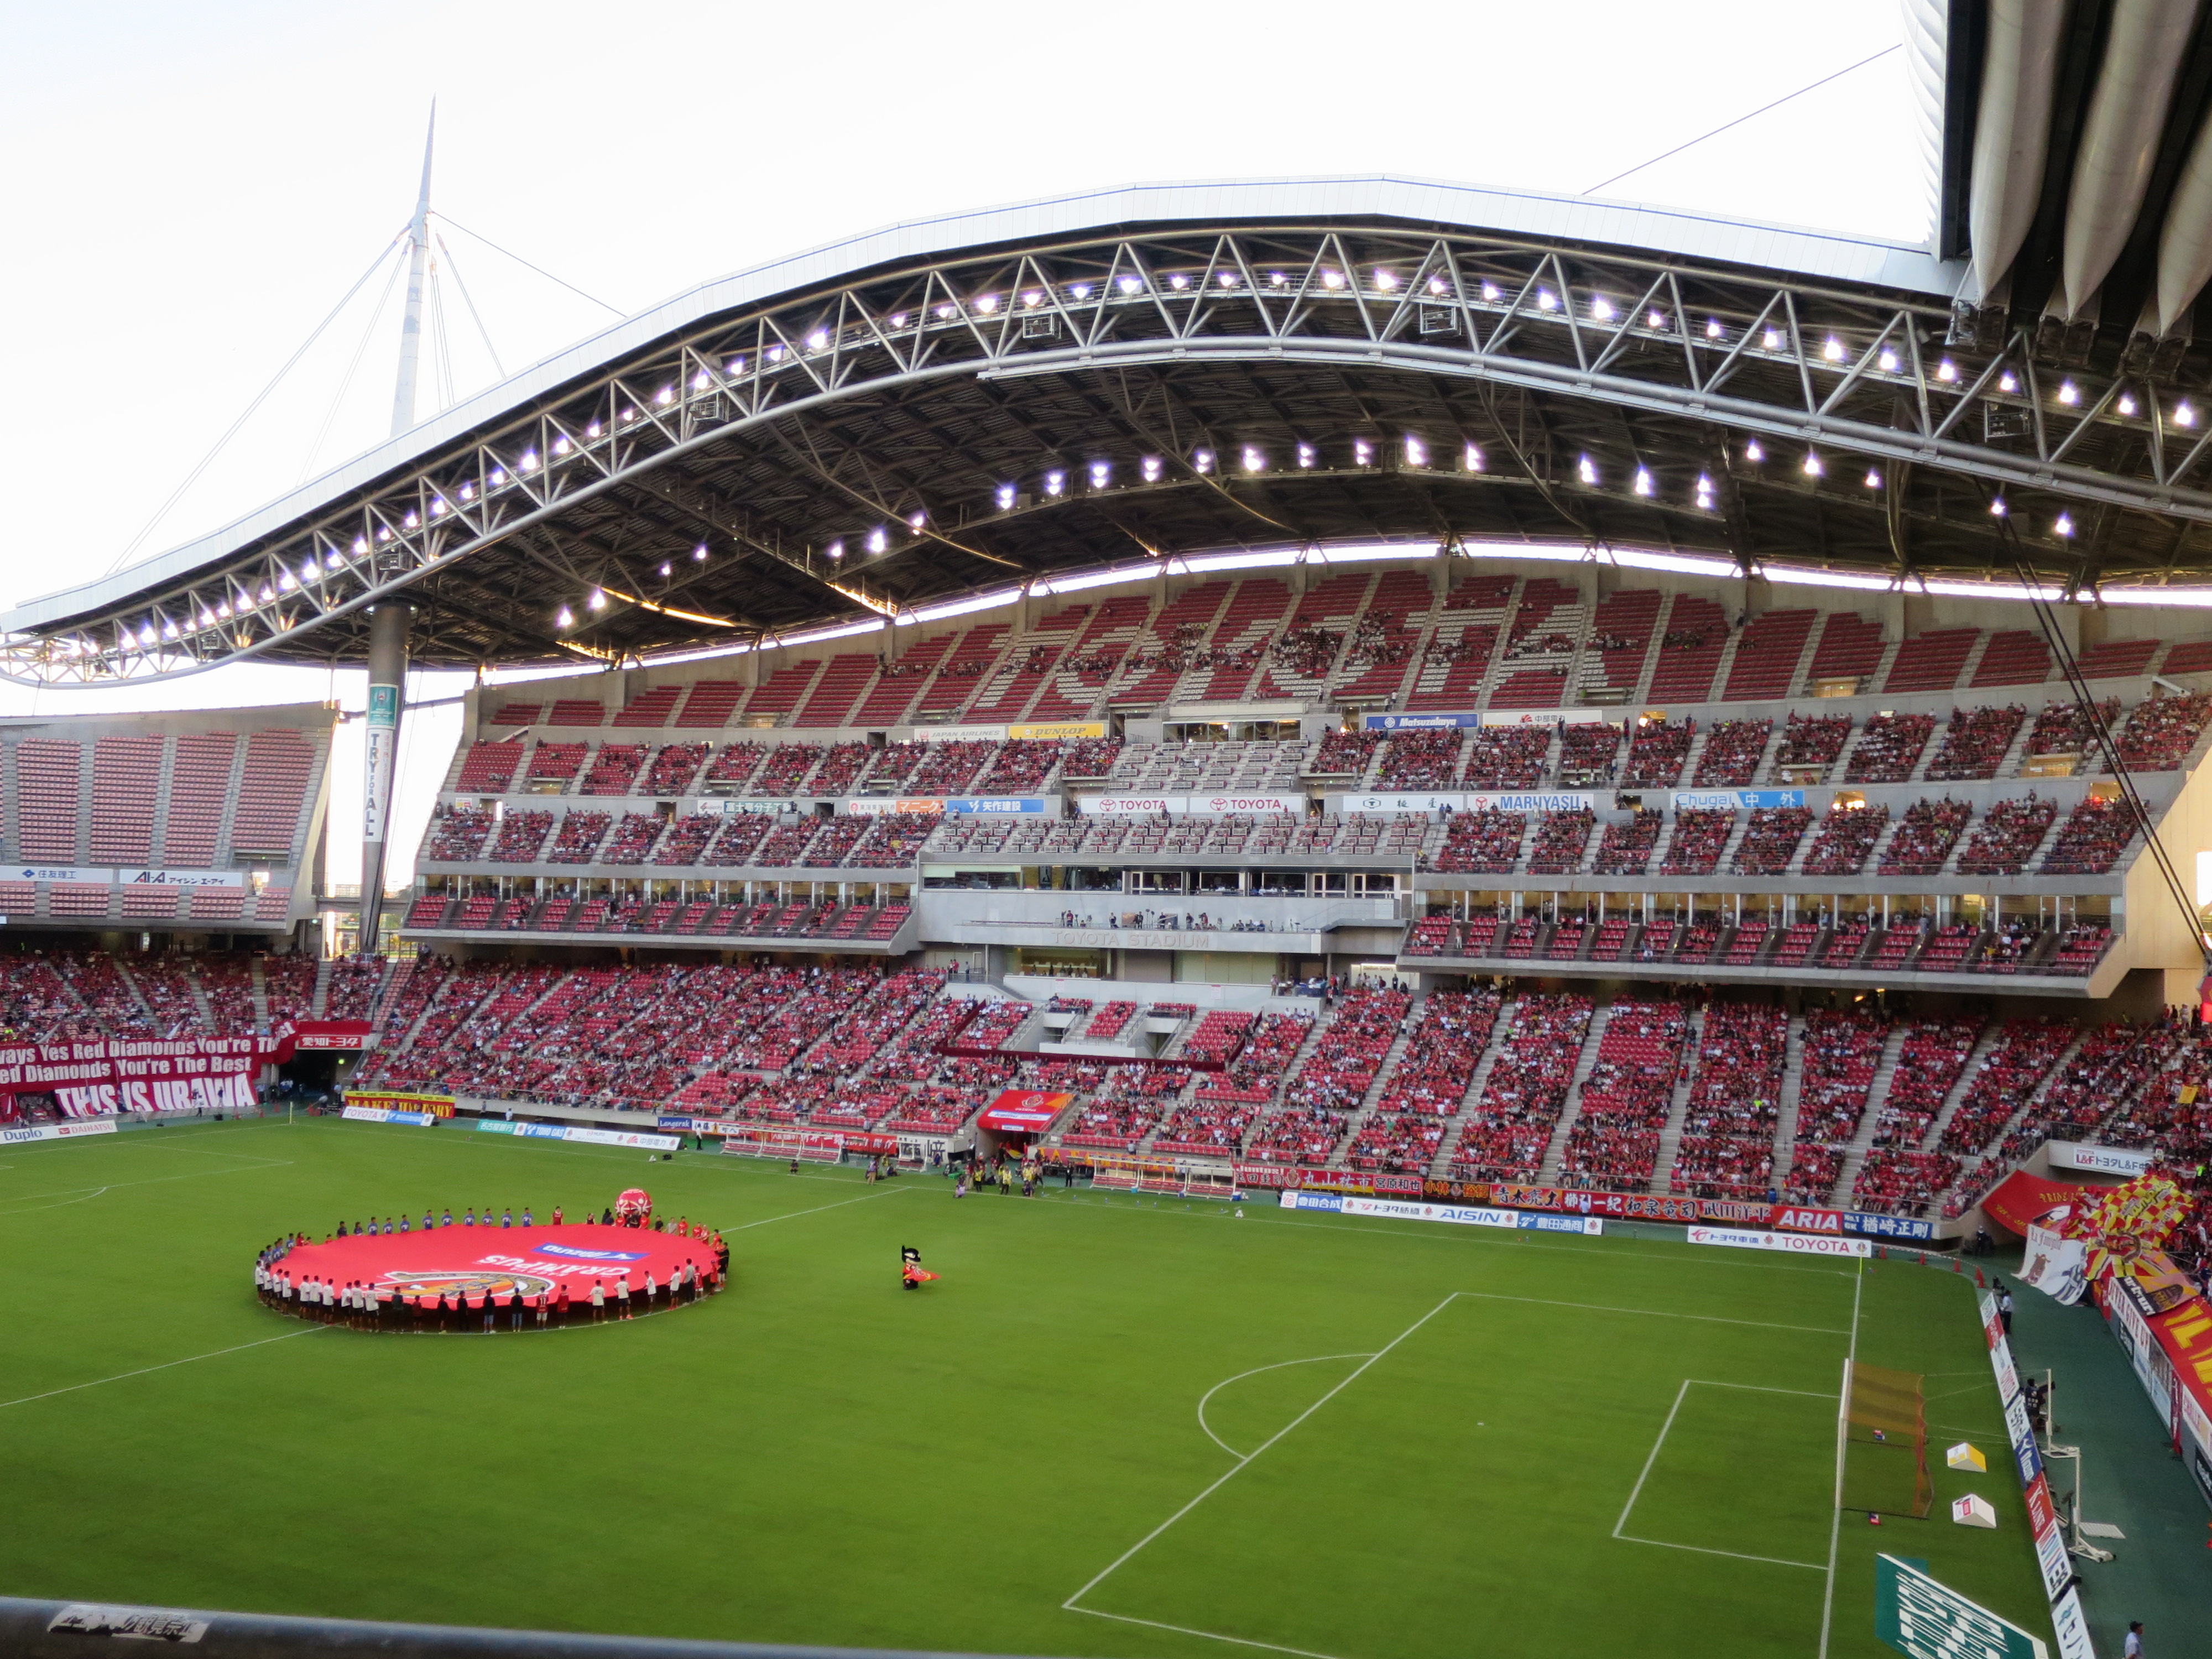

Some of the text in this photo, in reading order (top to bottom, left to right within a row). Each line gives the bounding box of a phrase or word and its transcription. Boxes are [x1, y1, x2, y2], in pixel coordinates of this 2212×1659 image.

[1399, 717, 1457, 728] Matsuzakaya
[1034, 727, 1087, 735] DUNLOP
[983, 801, 1021, 811] 矢作建設
[1119, 800, 1166, 810] TOYOTA
[1231, 800, 1282, 809] TOYOTA
[1500, 796, 1579, 809] MARUYASU
[1676, 793, 1732, 807] Chugai
[38, 870, 76, 879] 住友理工
[1051, 931, 1209, 948] TOYOTA STADIUM
[302, 1037, 358, 1047] 愛知トヨタ
[39, 1045, 69, 1061] Yes
[73, 1042, 105, 1060] Red
[109, 1040, 196, 1057] Diamonds
[196, 1037, 251, 1054] You're
[25, 1061, 111, 1083] Diamonds
[117, 1057, 170, 1076] You're
[174, 1057, 207, 1074] The
[211, 1056, 252, 1073] Best
[54, 1073, 255, 1118] THIS IS URAWA
[347, 1108, 378, 1119] TOYOTA
[71, 1123, 113, 1134] DAIHATSU
[660, 1119, 690, 1128] Langerak
[4, 1129, 43, 1141] Duplo
[535, 1127, 564, 1137] TOHO GAS
[640, 1138, 666, 1146] 中部電力
[2076, 1154, 2094, 1165] L&F
[1303, 1171, 1372, 1190] 丸山祐市
[1375, 1177, 1420, 1192] 宮原和也
[1424, 1180, 1489, 1198] 小林 裕紀
[1297, 1197, 1342, 1209] 豊田合成
[1494, 1187, 1560, 1208] 青木亮太
[1374, 1204, 1420, 1215] トヨタ紡織
[1626, 1199, 1697, 1218] 和泉竜司
[1702, 1201, 1770, 1222] 武田洋平
[1439, 1208, 1501, 1223] AISIN
[1778, 1209, 1839, 1230] ARIA
[1537, 1218, 1583, 1232] 豊田通商
[1710, 1234, 1759, 1244] トヨタ車体
[1783, 1237, 1850, 1253] TOYOTA
[479, 1255, 632, 1276] GRAMPUS
